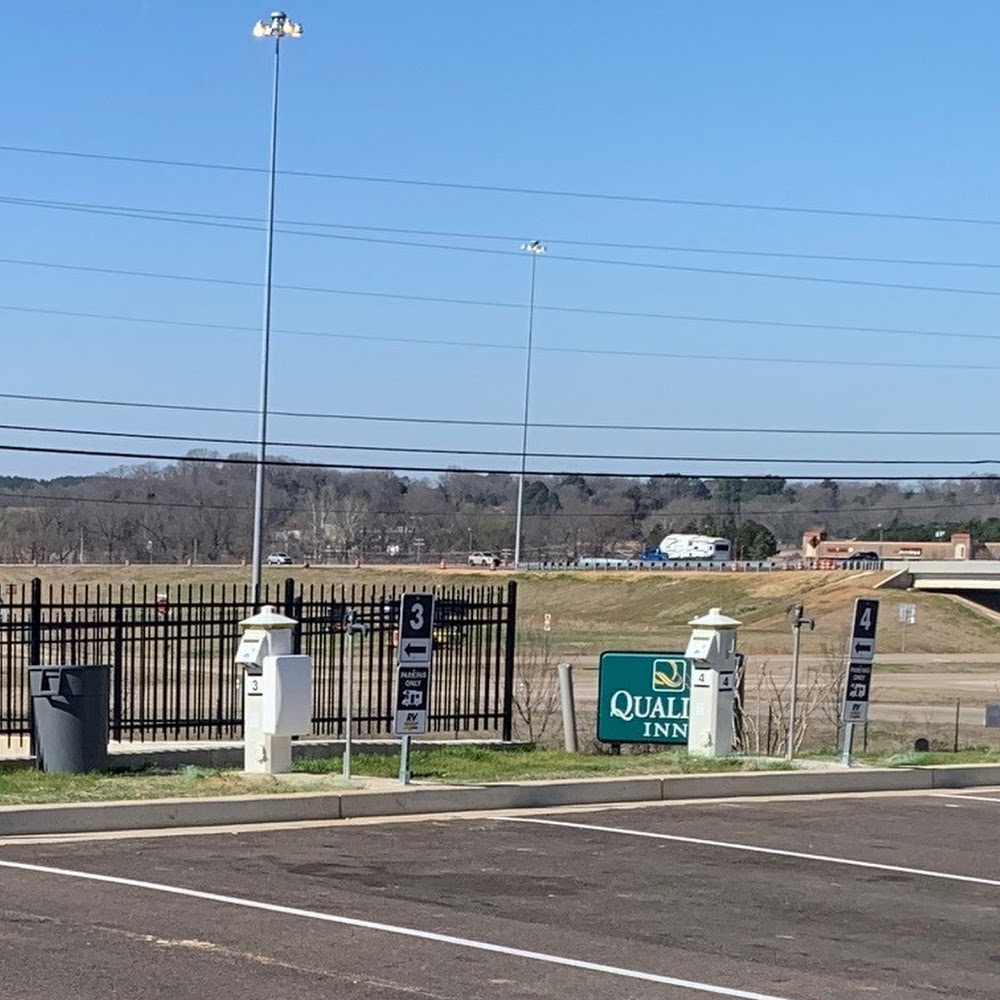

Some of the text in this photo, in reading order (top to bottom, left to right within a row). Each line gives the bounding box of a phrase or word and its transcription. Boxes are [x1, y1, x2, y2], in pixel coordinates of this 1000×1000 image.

[409, 603, 424, 630] 3
[860, 607, 871, 630] 4
[698, 673, 704, 682] 4
[722, 676, 729, 686] 4
[252, 680, 258, 691] 3
[610, 690, 690, 721] QUALI
[643, 722, 687, 737] INN
